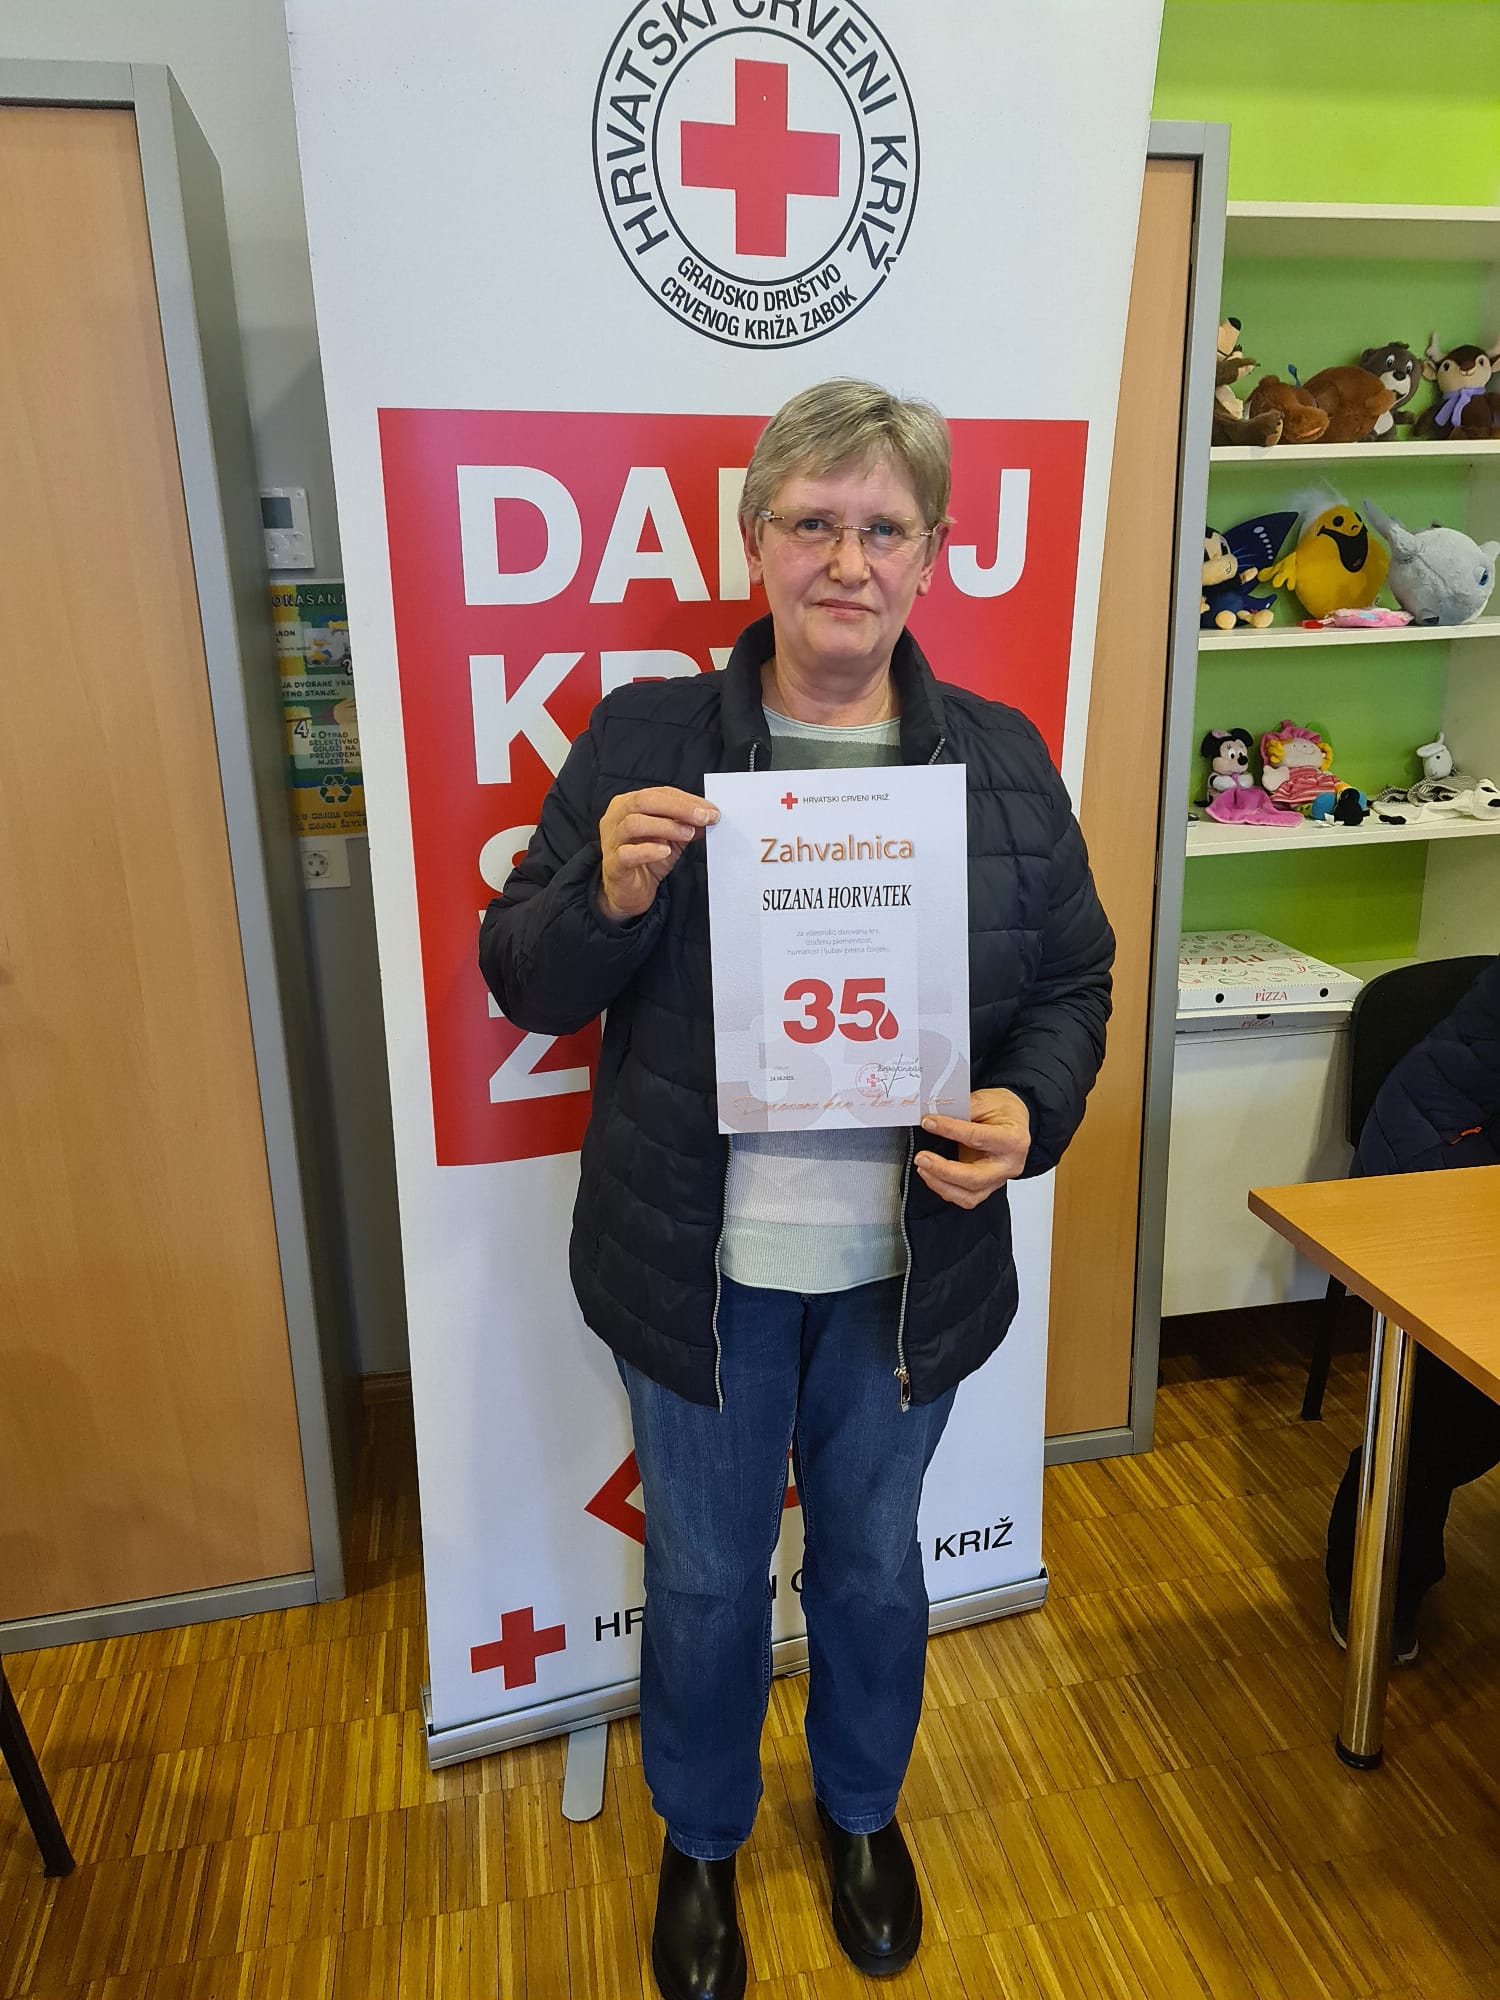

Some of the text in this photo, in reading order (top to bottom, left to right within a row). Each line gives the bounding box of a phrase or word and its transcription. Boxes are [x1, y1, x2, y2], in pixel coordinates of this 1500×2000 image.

[606, 0, 717, 256] HRVATSKI
[846, 135, 908, 273] KRIŽ
[677, 255, 842, 312] GRADSKO DRUŠTVO
[660, 276, 859, 340] CRVENOG KRIŽA ZABOK
[456, 464, 1031, 607] DAJ
[295, 719, 309, 738] 4
[309, 738, 359, 746] SELEKTIVNO
[802, 792, 889, 804] HRVATSKI CRVENI KRIŽ
[760, 834, 915, 863] Zahvalnica
[762, 884, 912, 911] SUZANA HORVATEK
[783, 977, 886, 1044] 35
[934, 1515, 1014, 1562] KRIŽ
